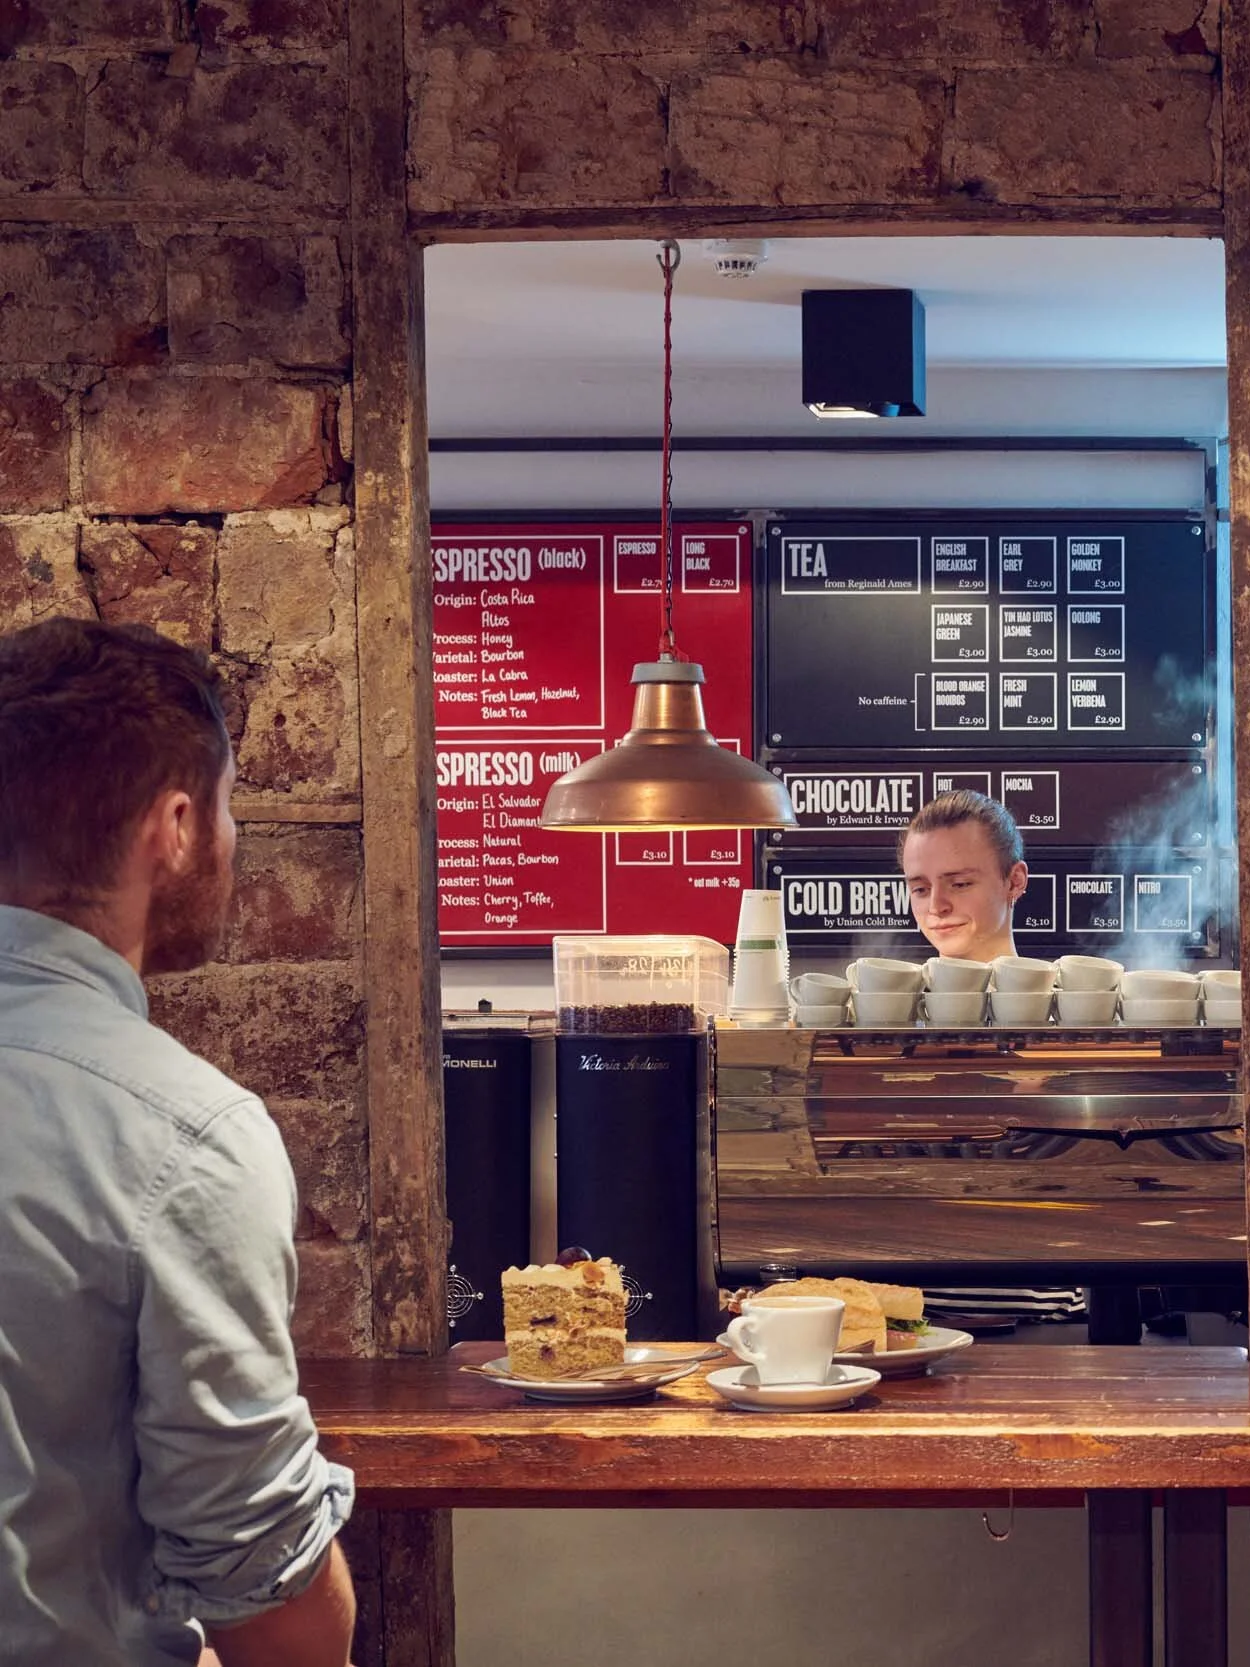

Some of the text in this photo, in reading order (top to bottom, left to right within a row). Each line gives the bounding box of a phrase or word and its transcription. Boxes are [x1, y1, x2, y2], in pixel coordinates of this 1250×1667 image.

[618, 542, 656, 554] ESPRESSO
[686, 542, 705, 554] LONG
[936, 543, 966, 556] ENGLISH
[1003, 543, 1022, 556] EARL
[1071, 543, 1100, 556] GOLDEN
[431, 547, 586, 582] SPRESSO (black)
[686, 558, 710, 570] BLACK
[788, 543, 828, 577] TEA
[936, 558, 977, 572] BREAKFAST
[1003, 558, 1023, 572] GREY
[1071, 558, 1102, 572] MONKEY
[709, 578, 734, 588] £2.70
[824, 578, 912, 590] from Reginald Ames
[958, 579, 984, 589] £2.90
[1026, 579, 1052, 589] £2.90
[1094, 579, 1120, 589] £3.00
[434, 587, 535, 609] Origin: Costa Rica
[481, 610, 510, 628] Altos
[936, 612, 973, 626] JAPANESE
[1004, 611, 1016, 622] YIN
[1032, 611, 1053, 622] LOTUS
[1072, 611, 1101, 624] OOLONG
[936, 627, 960, 641] GREEN
[1004, 624, 1032, 638] JASMINE
[481, 632, 513, 649] Honey
[481, 649, 524, 663] Bourbon
[958, 648, 984, 658] £3.00
[1026, 647, 1052, 658] £3.00
[1094, 647, 1120, 658] £3.00
[481, 668, 496, 684] La
[499, 668, 528, 682] Cabra
[936, 680, 986, 692] BLOOD ORANGE
[1004, 679, 1027, 692] FRESH
[1072, 679, 1097, 692] LEMON
[438, 686, 580, 704] Notes: Fresh Lemon, Hazelnut,
[858, 696, 908, 706] No caffeine
[936, 694, 966, 706] ROOIBOS
[1004, 694, 1023, 708] MINT
[1072, 694, 1106, 708] VERBENA
[481, 706, 528, 720] Black Tea
[958, 716, 984, 726] £2.90
[1026, 714, 1053, 726] £2.90
[1094, 714, 1121, 726] £2.90
[436, 751, 581, 786] SPRESSO (milk)
[938, 778, 953, 791] HOT
[1005, 778, 1034, 792] MOCHA
[437, 792, 542, 813] Origin: El Salvador
[791, 778, 914, 814] CHOCOLATE
[483, 812, 496, 829] El
[826, 814, 910, 826] by Edward & Irwyn
[1029, 814, 1054, 824] £3.50
[438, 833, 522, 848] rocess: Natural
[438, 852, 559, 868] arietal: Pacas, Bourbon
[642, 850, 667, 860] £3.10
[710, 849, 735, 860] £3.10
[438, 874, 514, 887] oaster: Union
[706, 877, 720, 888] milk
[722, 877, 740, 888] +35p
[1070, 881, 1113, 894] CHOCOLATE
[1138, 881, 1161, 894] NITRO
[441, 891, 554, 911] Notes: Cherry, Toffee,
[788, 881, 912, 916] COLD BREW
[484, 912, 518, 928] Orange
[824, 917, 910, 928] by Union Cold Brew
[1026, 917, 1050, 927] £3.10
[1094, 917, 1118, 927] £3.50
[579, 1054, 621, 1072] Victoria
